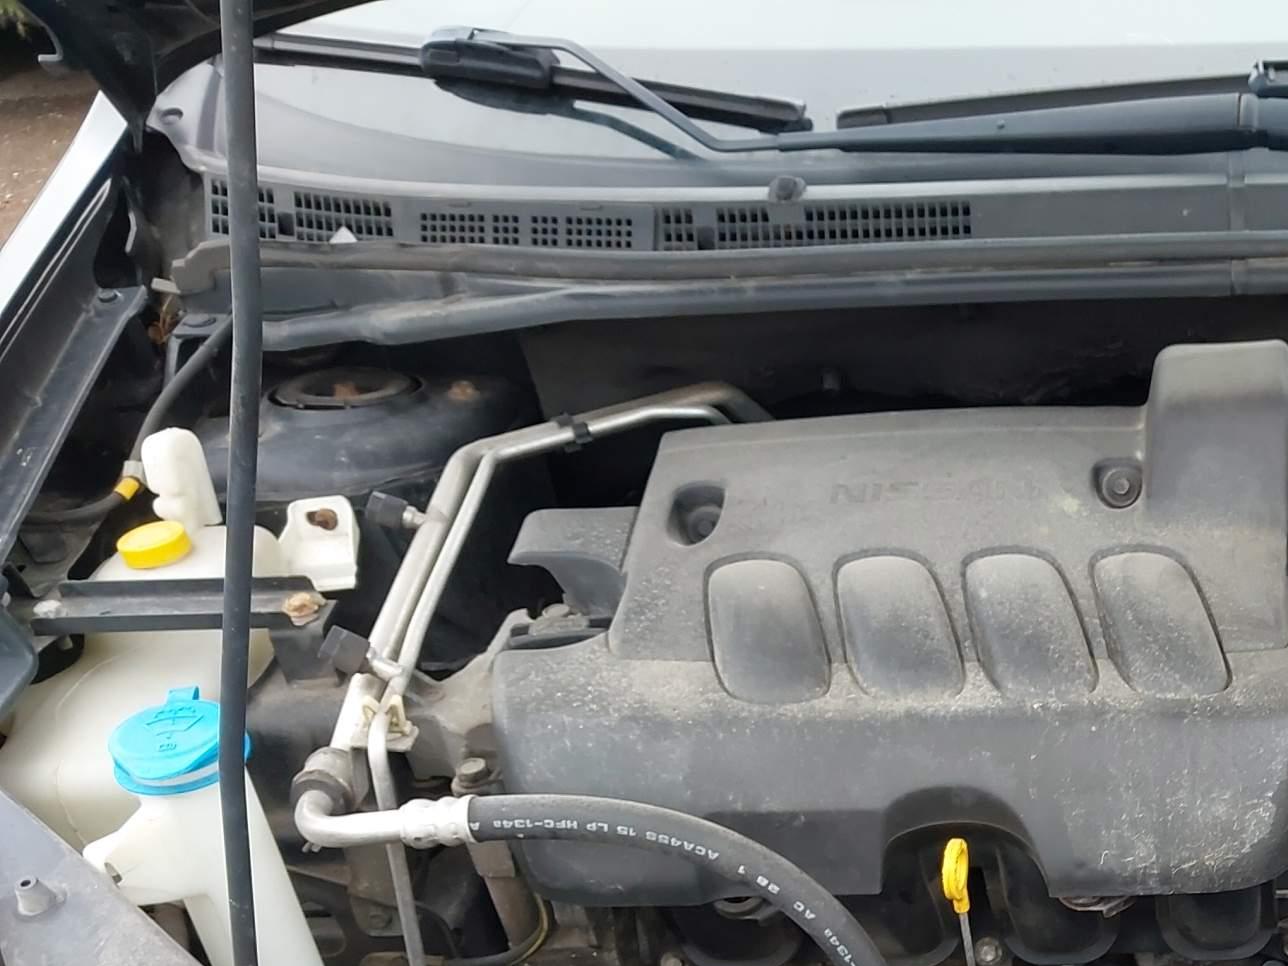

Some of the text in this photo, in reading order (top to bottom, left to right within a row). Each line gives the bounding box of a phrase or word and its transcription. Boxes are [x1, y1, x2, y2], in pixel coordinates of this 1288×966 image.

[585, 821, 609, 833] LP
[616, 825, 637, 837] 15
[794, 900, 816, 921] AC
